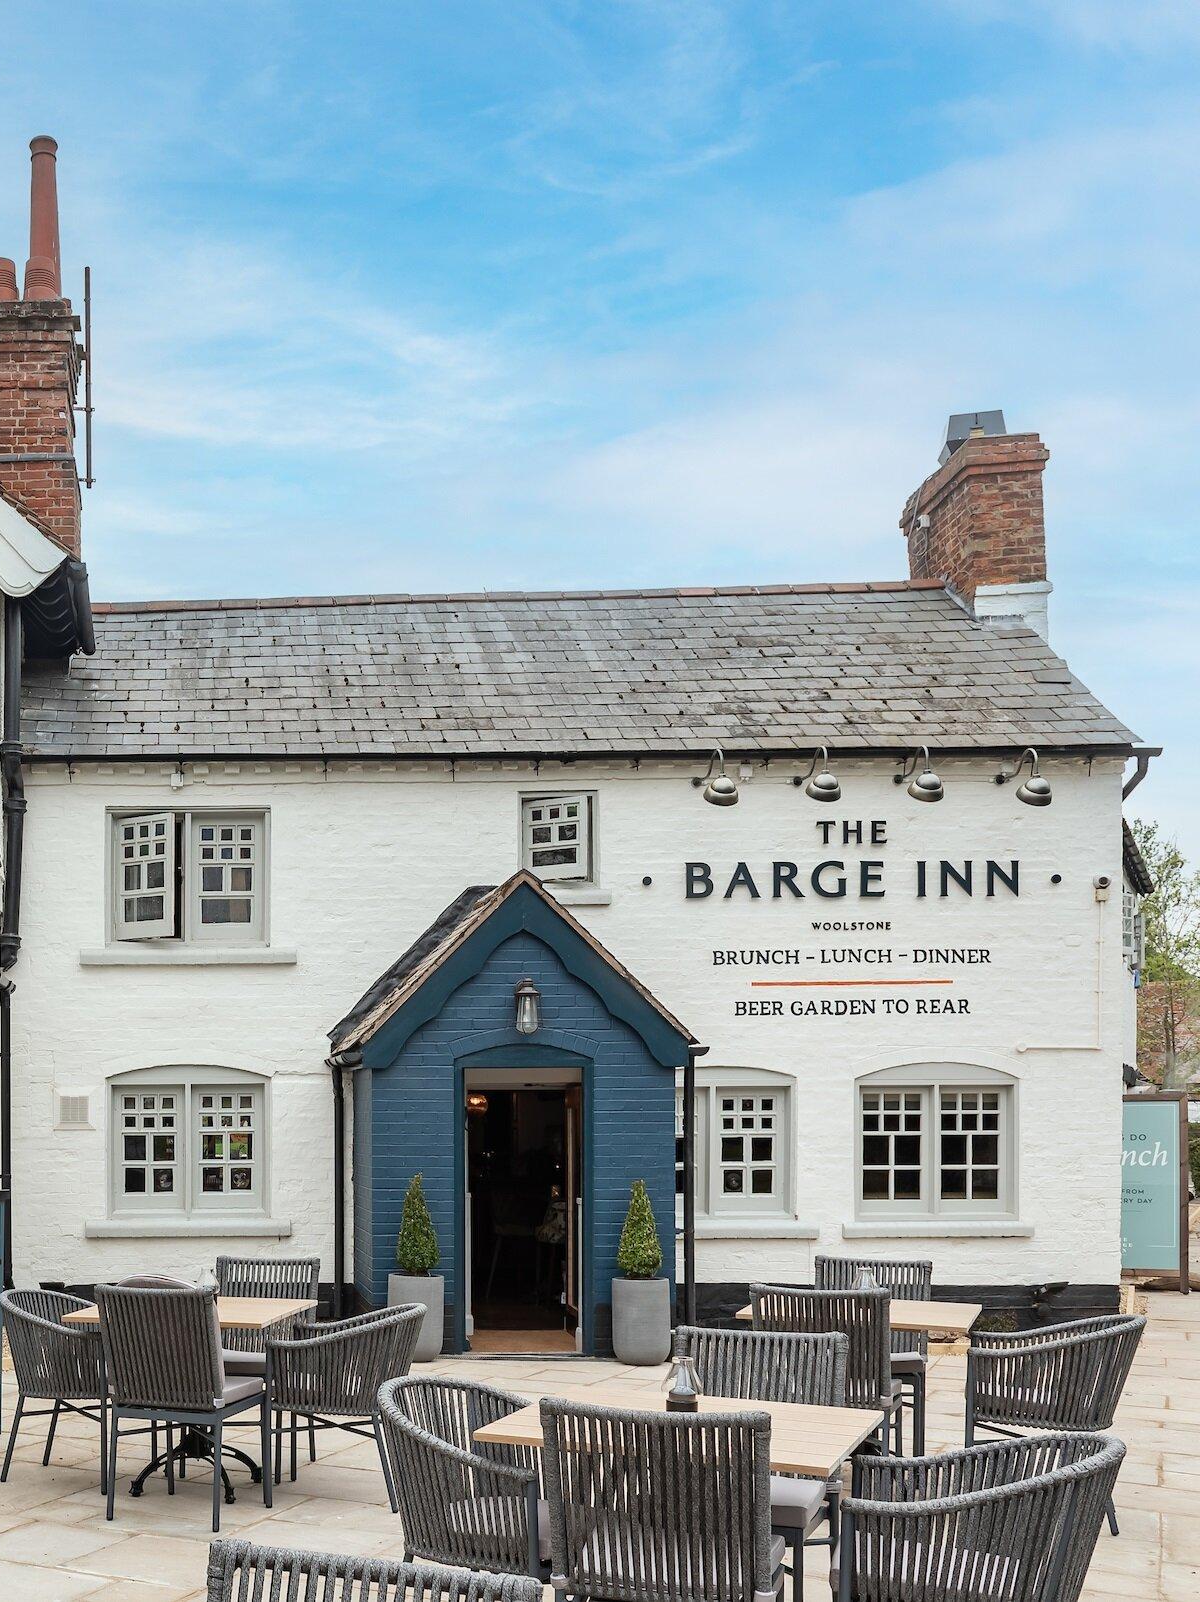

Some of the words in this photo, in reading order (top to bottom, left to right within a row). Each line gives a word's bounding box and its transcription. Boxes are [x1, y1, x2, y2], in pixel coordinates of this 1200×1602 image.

[816, 820, 888, 844] THE
[684, 860, 886, 899] BARGE
[916, 860, 1020, 898] INN
[811, 921, 892, 931] WOOLSTONE
[712, 950, 800, 966] BRUNCH
[820, 949, 892, 964] LUNCH
[912, 949, 991, 964] DINNER
[734, 1000, 784, 1016] BEER
[790, 999, 876, 1016] GARDEN
[882, 1000, 909, 1015] TO
[916, 999, 971, 1015] REAR
[1130, 1133, 1147, 1141] DO
